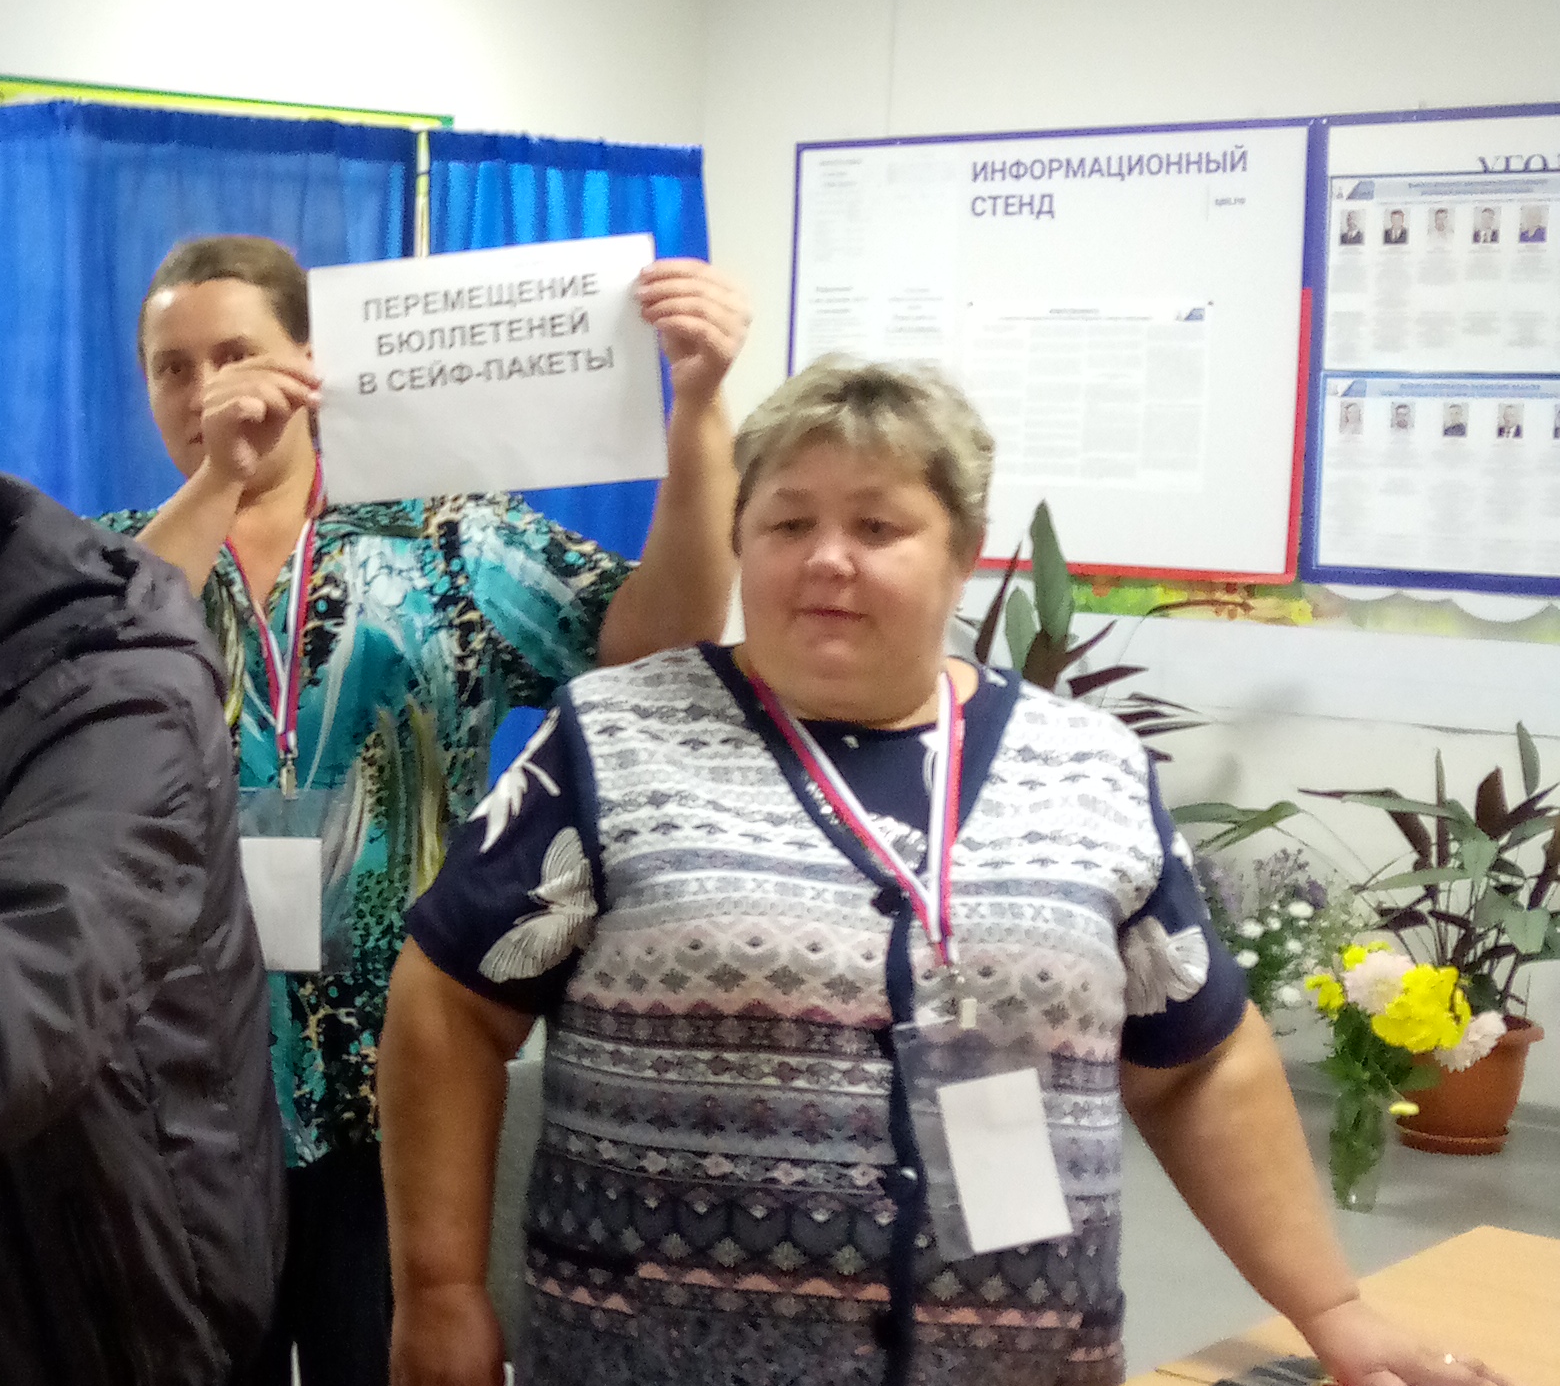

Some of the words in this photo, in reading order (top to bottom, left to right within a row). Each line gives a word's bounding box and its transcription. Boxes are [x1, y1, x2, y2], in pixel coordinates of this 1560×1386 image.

[971, 144, 1248, 183] ИНФОРМАЦИОННЫЙ
[971, 193, 1055, 219] СТЕНД
[362, 273, 600, 322] ПЕРЕМЕЩЕНИЕ
[377, 307, 590, 357] БЮЛЛЕТЕНЕЙ
[358, 372, 377, 395] В
[386, 347, 615, 393] СЕЙФ-ПАКЕТЫ
